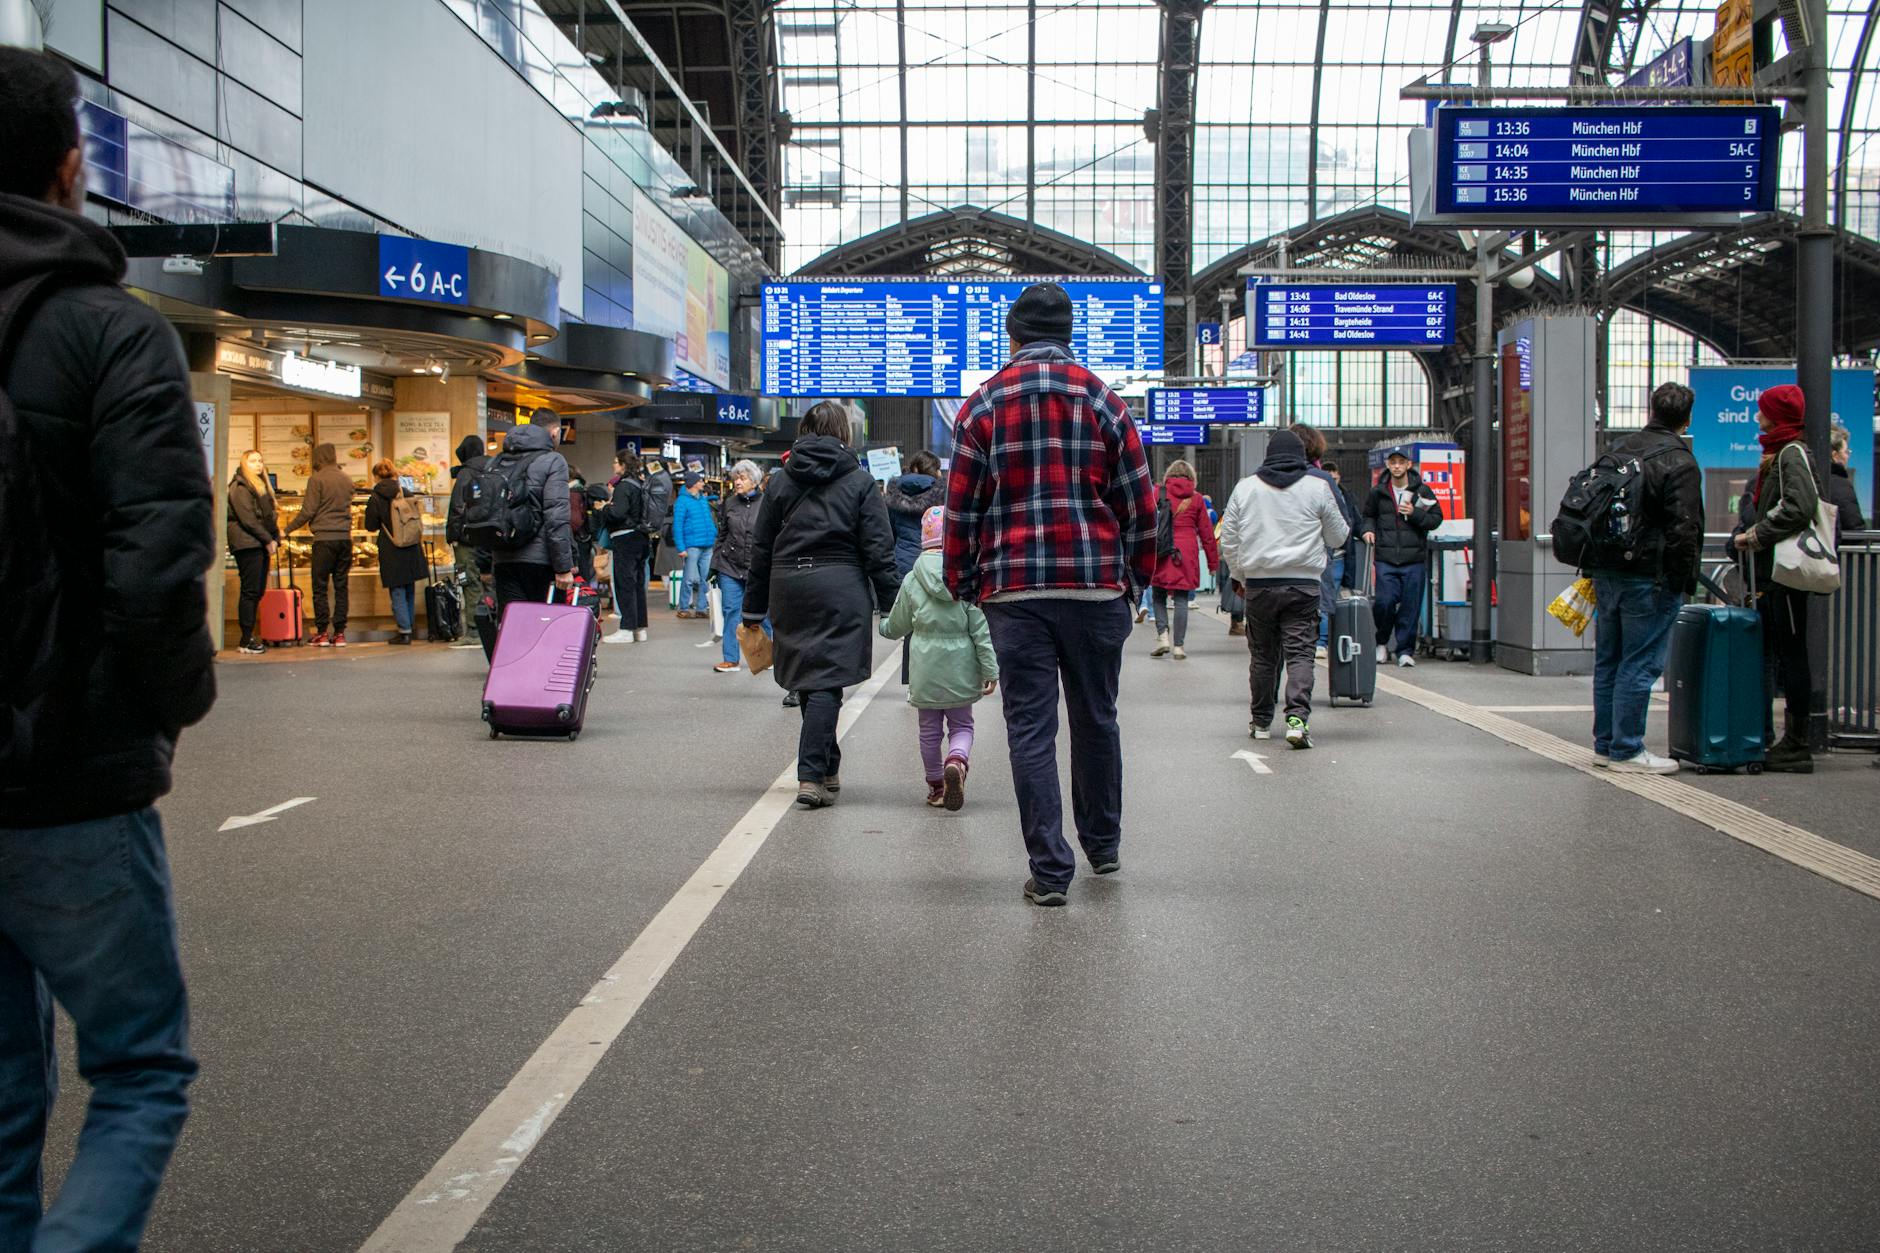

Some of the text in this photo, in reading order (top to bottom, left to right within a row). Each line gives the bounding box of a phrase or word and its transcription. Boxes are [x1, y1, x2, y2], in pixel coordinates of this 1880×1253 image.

[1496, 121, 1642, 136] 13:36 München Hbf
[1747, 120, 1755, 132] 5
[1495, 144, 1642, 158] 14:04 München Hbf
[1730, 142, 1755, 156] 5A-C
[1494, 166, 1640, 180] 14:35 München Hbf
[1745, 166, 1753, 178] 5
[1494, 188, 1639, 202] 15:36 München Hbf
[1744, 188, 1752, 200] 5
[410, 262, 463, 298] 6 A-C
[770, 276, 885, 284] Willkommen
[1068, 275, 1154, 284] Hamburg
[1290, 292, 1376, 300] 13:41 Bad Oldesloe
[1428, 292, 1444, 300] 6A-C
[1290, 304, 1394, 314] 14:06 Travemünde Strand
[1427, 304, 1443, 313] 6A-C
[1289, 317, 1372, 328] 14:11 Bargteheide
[1426, 317, 1442, 326] 6D-F
[1202, 328, 1211, 344] 8
[1289, 330, 1375, 339] 14:41 Bad Oldesloe
[1426, 330, 1442, 339] 6A-C
[1731, 386, 1763, 402] Gut
[728, 404, 750, 421] 8 A-C
[1718, 407, 1749, 423] sind
